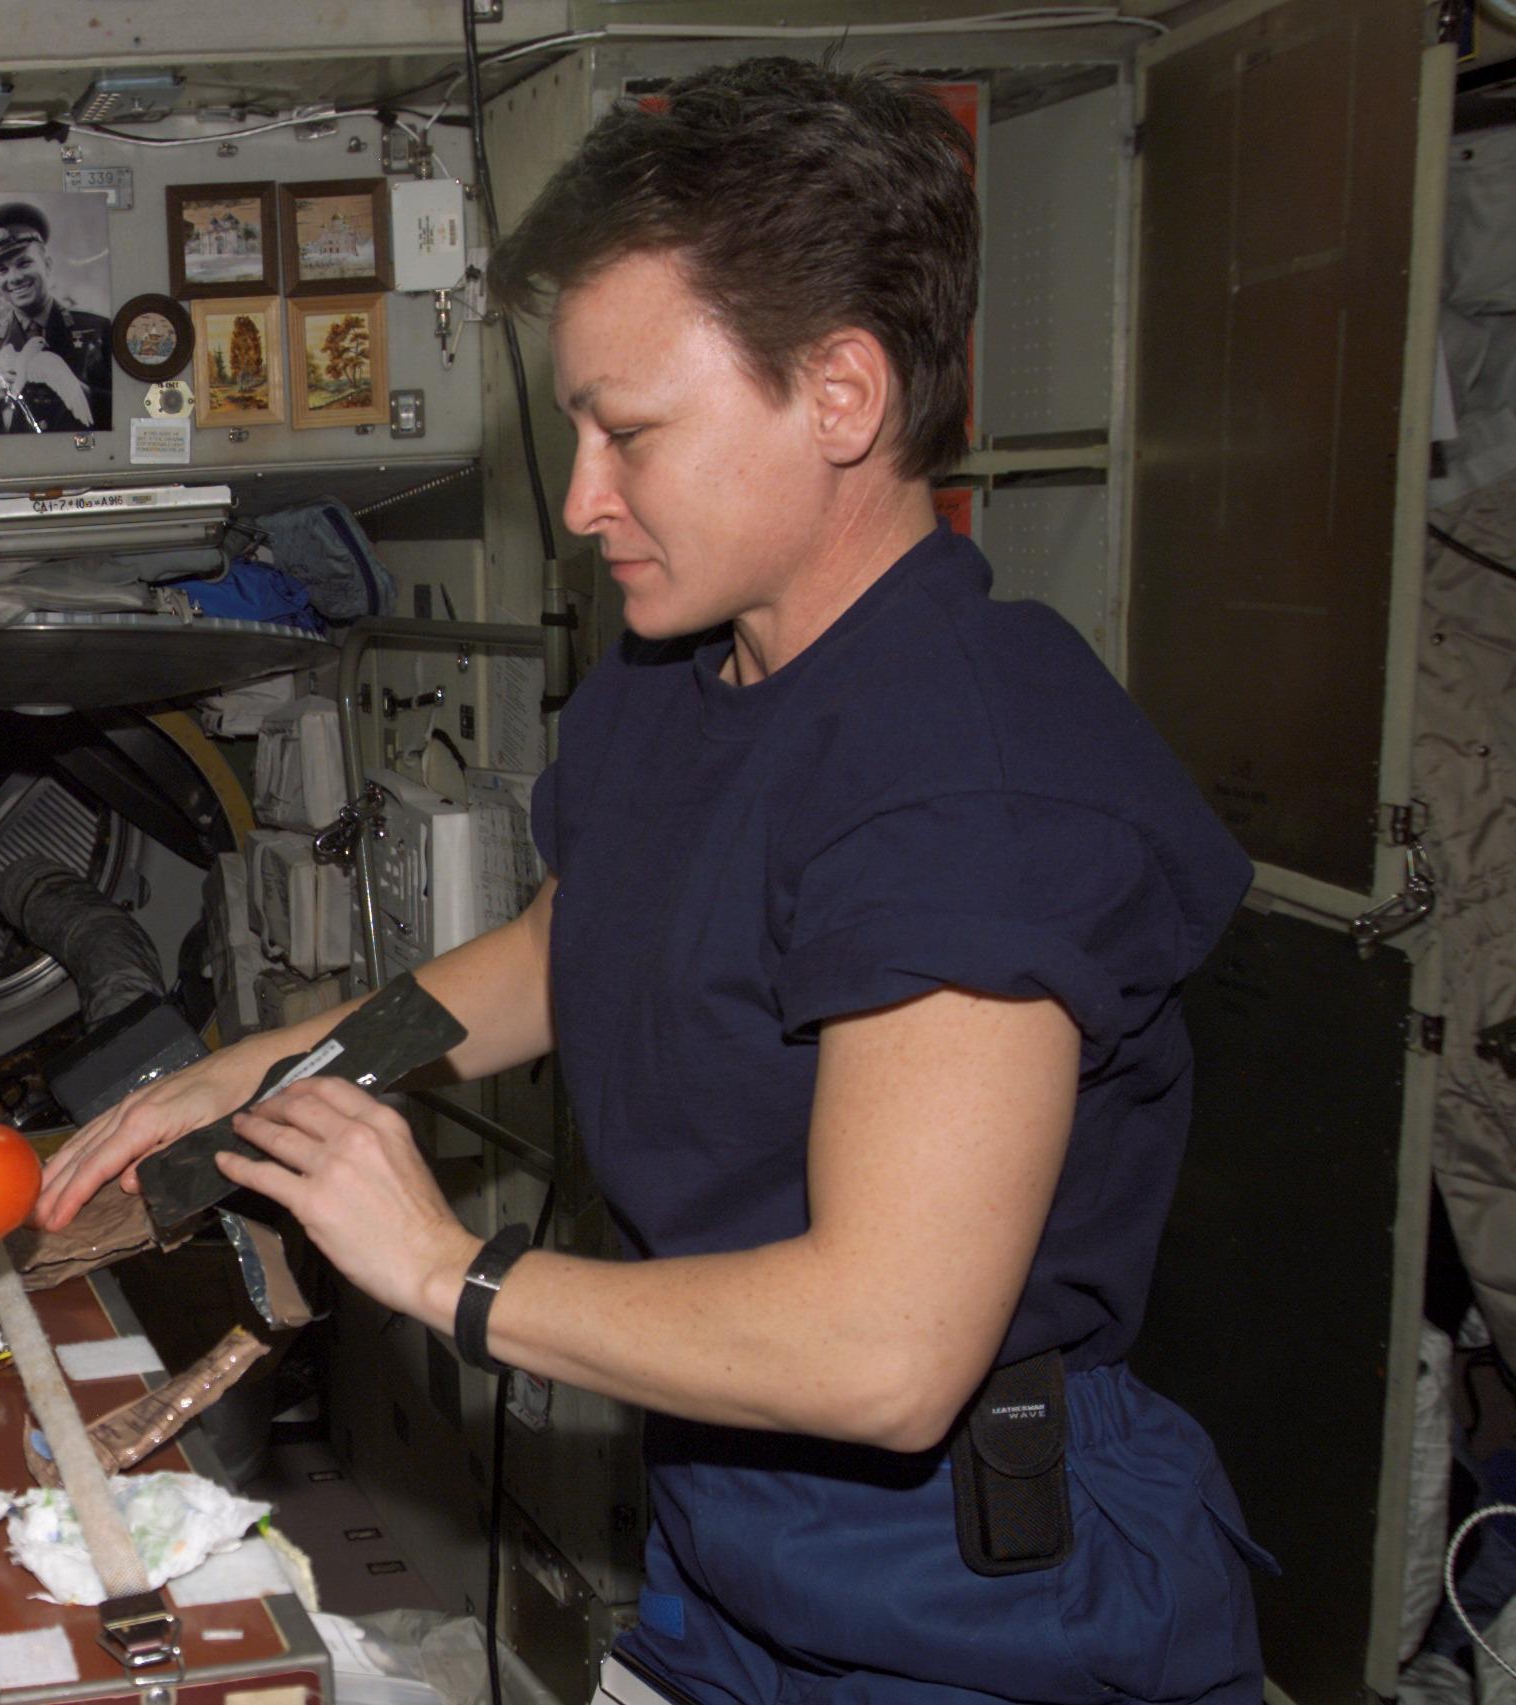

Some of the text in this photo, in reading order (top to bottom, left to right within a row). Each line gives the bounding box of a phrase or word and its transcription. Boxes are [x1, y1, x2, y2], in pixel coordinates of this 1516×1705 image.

[88, 171, 114, 185] 339
[991, 1404, 1045, 1414] LEATHERMAN
[1009, 1410, 1046, 1419] WAVE
